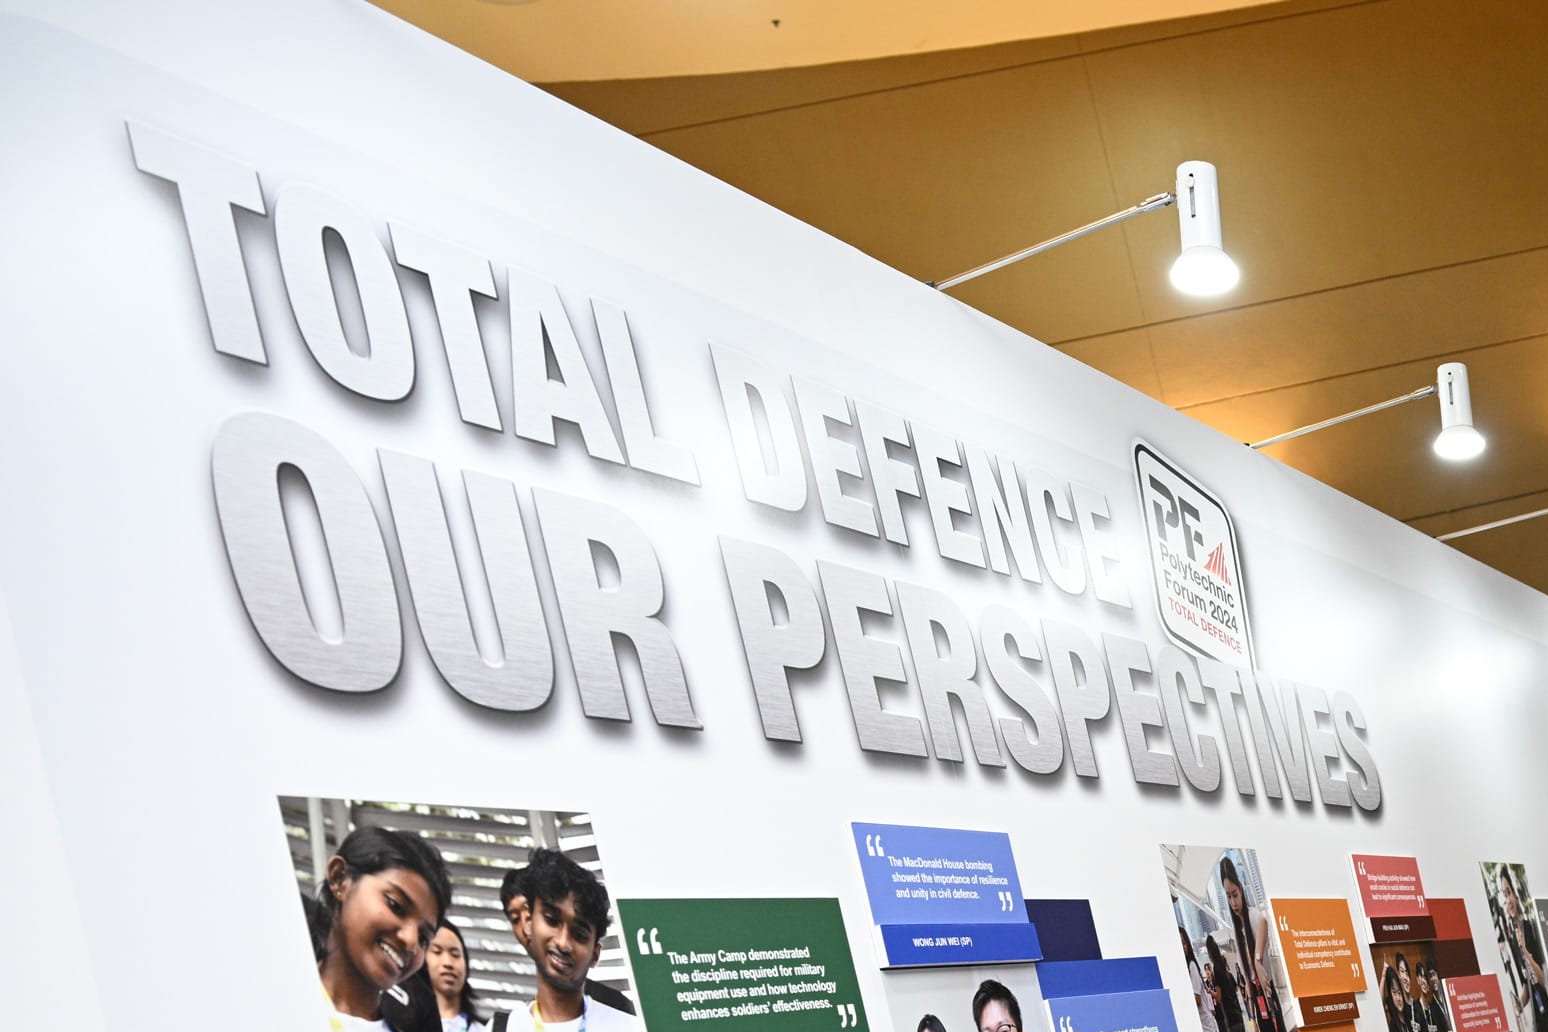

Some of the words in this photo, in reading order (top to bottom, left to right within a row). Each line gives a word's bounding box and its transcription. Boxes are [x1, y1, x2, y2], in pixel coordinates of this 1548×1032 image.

[124, 119, 702, 487] TOTAL
[708, 342, 1133, 610] DEFENCE
[1159, 541, 1234, 609] Polytechnic
[210, 411, 703, 731] OUR
[717, 533, 1383, 812] PERSPECTIVES
[1164, 569, 1207, 613] Forum
[1209, 600, 1239, 633] 2024
[1168, 597, 1199, 627] TOTAL
[1201, 618, 1242, 654] DEFENCE
[888, 856, 903, 867] The
[903, 857, 943, 868] MacDonald
[943, 859, 965, 869] House
[965, 861, 993, 873] bombing
[892, 873, 921, 883] showed
[921, 873, 933, 883] the
[934, 874, 971, 885] importance
[971, 875, 978, 884] of
[979, 876, 1008, 885] resilience
[896, 888, 911, 898] and
[911, 888, 929, 901] unity
[929, 888, 938, 898] in
[938, 889, 952, 898] civil
[953, 889, 980, 899] defence.
[913, 938, 934, 947] WONG
[935, 938, 948, 946] JUN
[947, 937, 960, 946] WEI
[960, 937, 973, 947] (SP)
[667, 952, 689, 965] The
[690, 952, 716, 966] Army
[718, 950, 747, 964] Camp
[749, 947, 810, 961] demonstrated
[672, 971, 690, 984] the
[691, 969, 739, 983] discipline
[740, 966, 779, 981] required
[779, 965, 793, 977] for
[794, 964, 825, 977] military
[677, 988, 730, 1004] equipment
[730, 988, 748, 998] use
[749, 984, 767, 997] and
[767, 984, 788, 995] how
[789, 981, 836, 994] technology
[682, 1008, 730, 1021] enhances
[773, 1000, 833, 1013] effectiveness.
